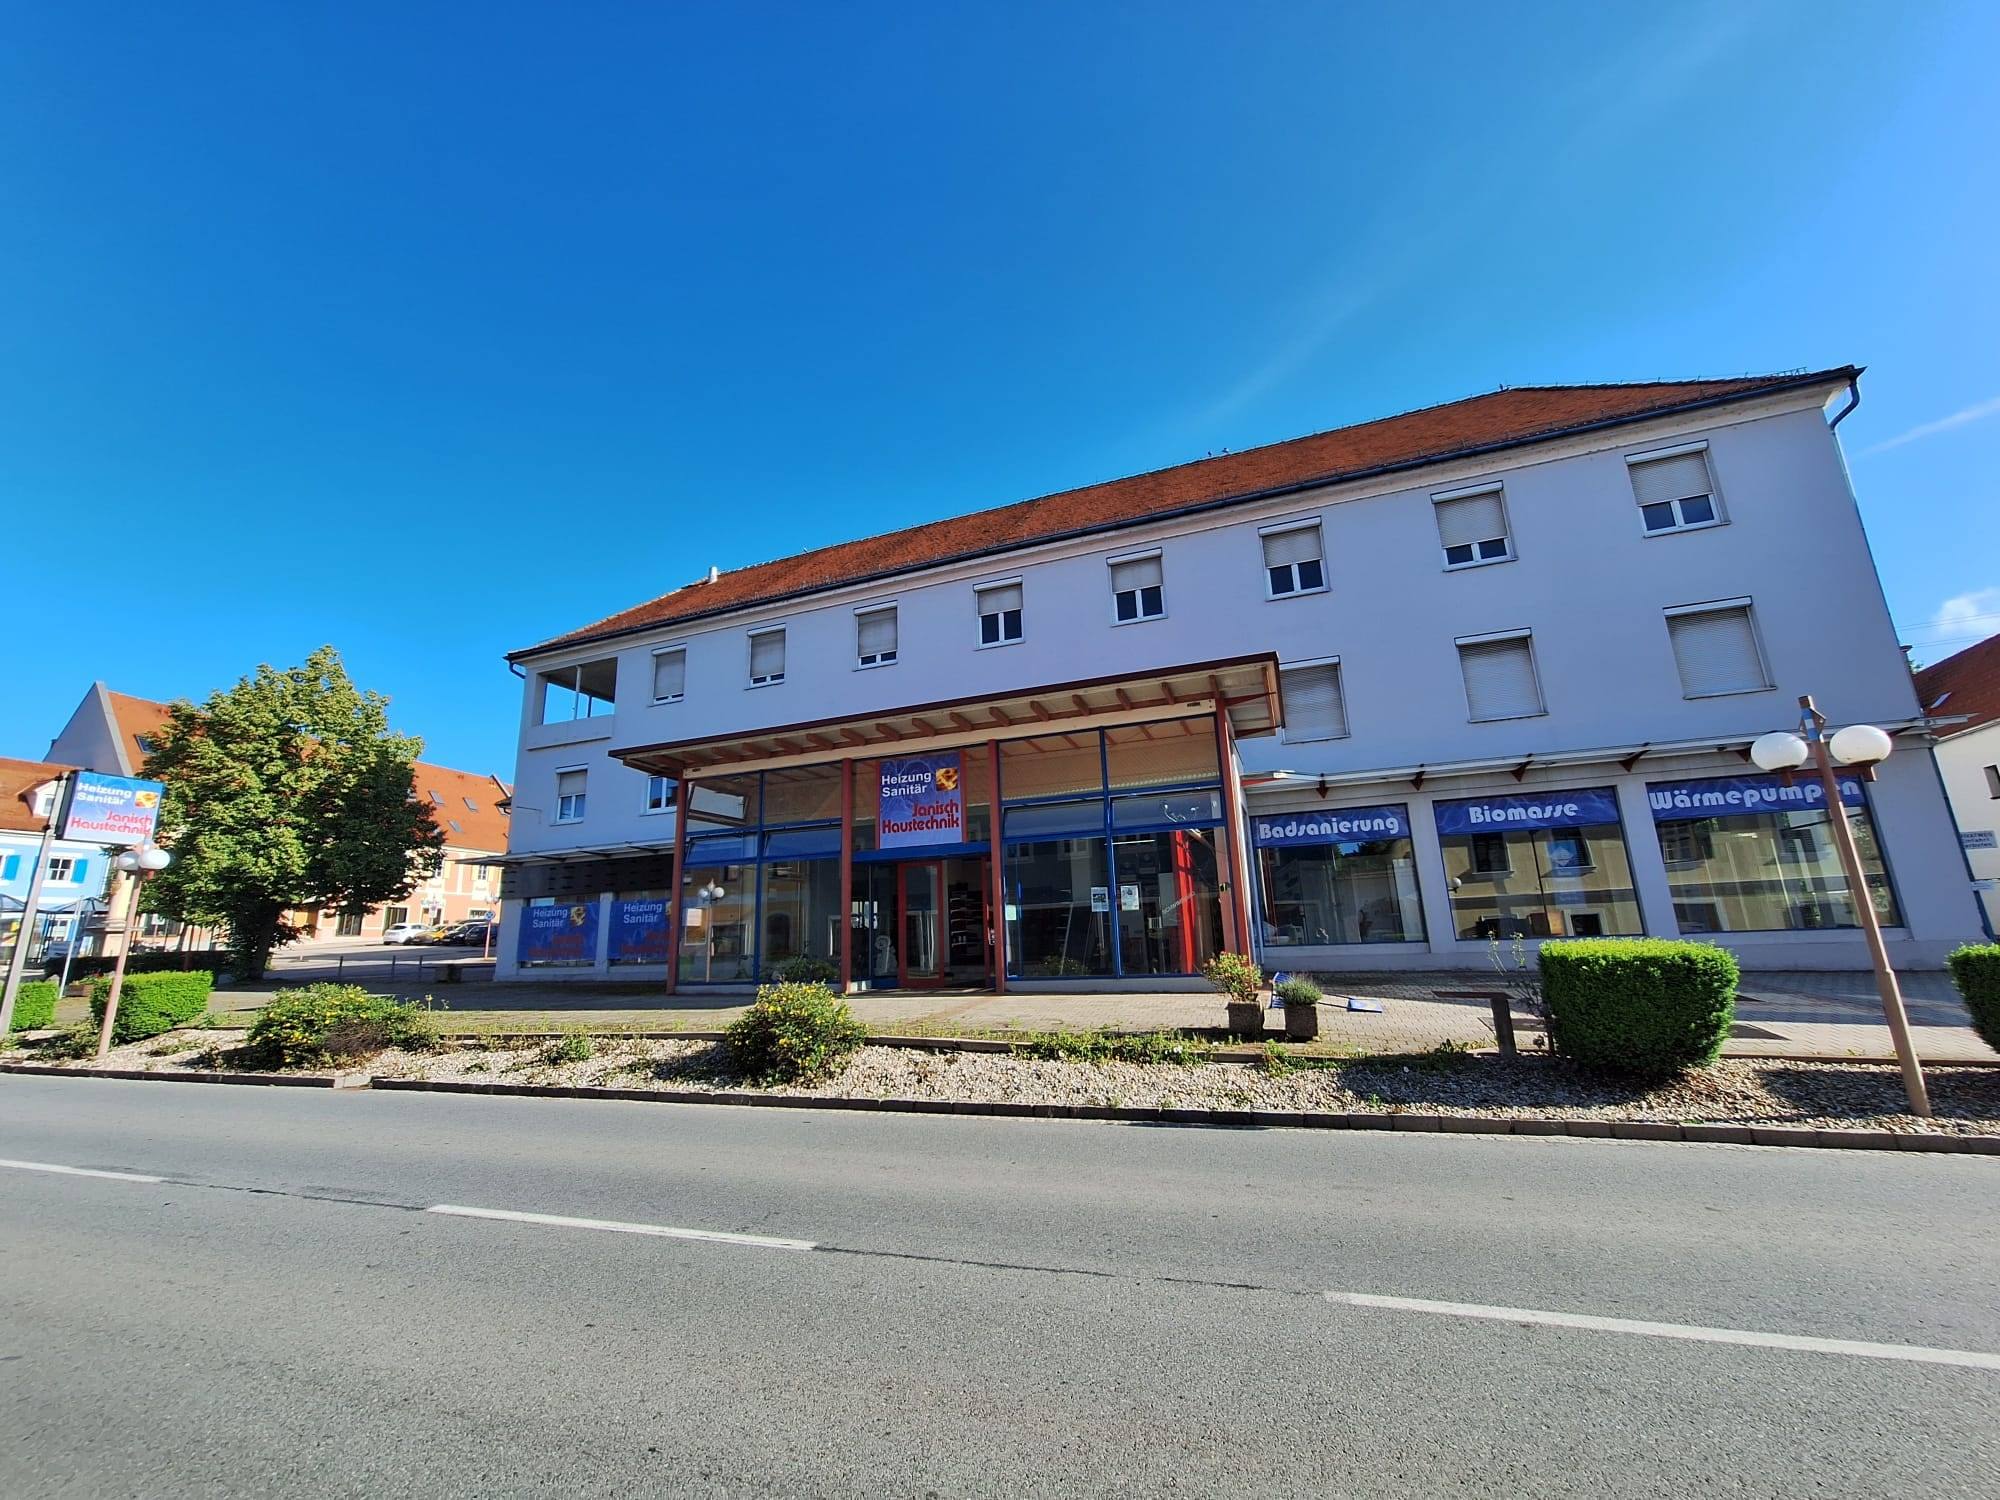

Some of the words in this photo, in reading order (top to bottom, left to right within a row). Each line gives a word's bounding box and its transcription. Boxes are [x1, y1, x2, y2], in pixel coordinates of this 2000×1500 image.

[882, 772, 931, 785] Heizung
[79, 783, 132, 798] Heizung
[882, 784, 927, 797] Sanitär
[1649, 782, 1860, 809] Wärmepumpn
[77, 792, 126, 805] Sanitär
[912, 799, 958, 817] Janisch
[1469, 803, 1579, 823] Biomasse
[106, 810, 153, 825] Janisch
[882, 814, 959, 833] Haustechnik
[1259, 817, 1399, 839] Badsanierung
[533, 908, 568, 918] Heizung
[624, 903, 662, 913] Heizung
[533, 919, 564, 928] Sanitär
[623, 914, 658, 924] Sanitär
